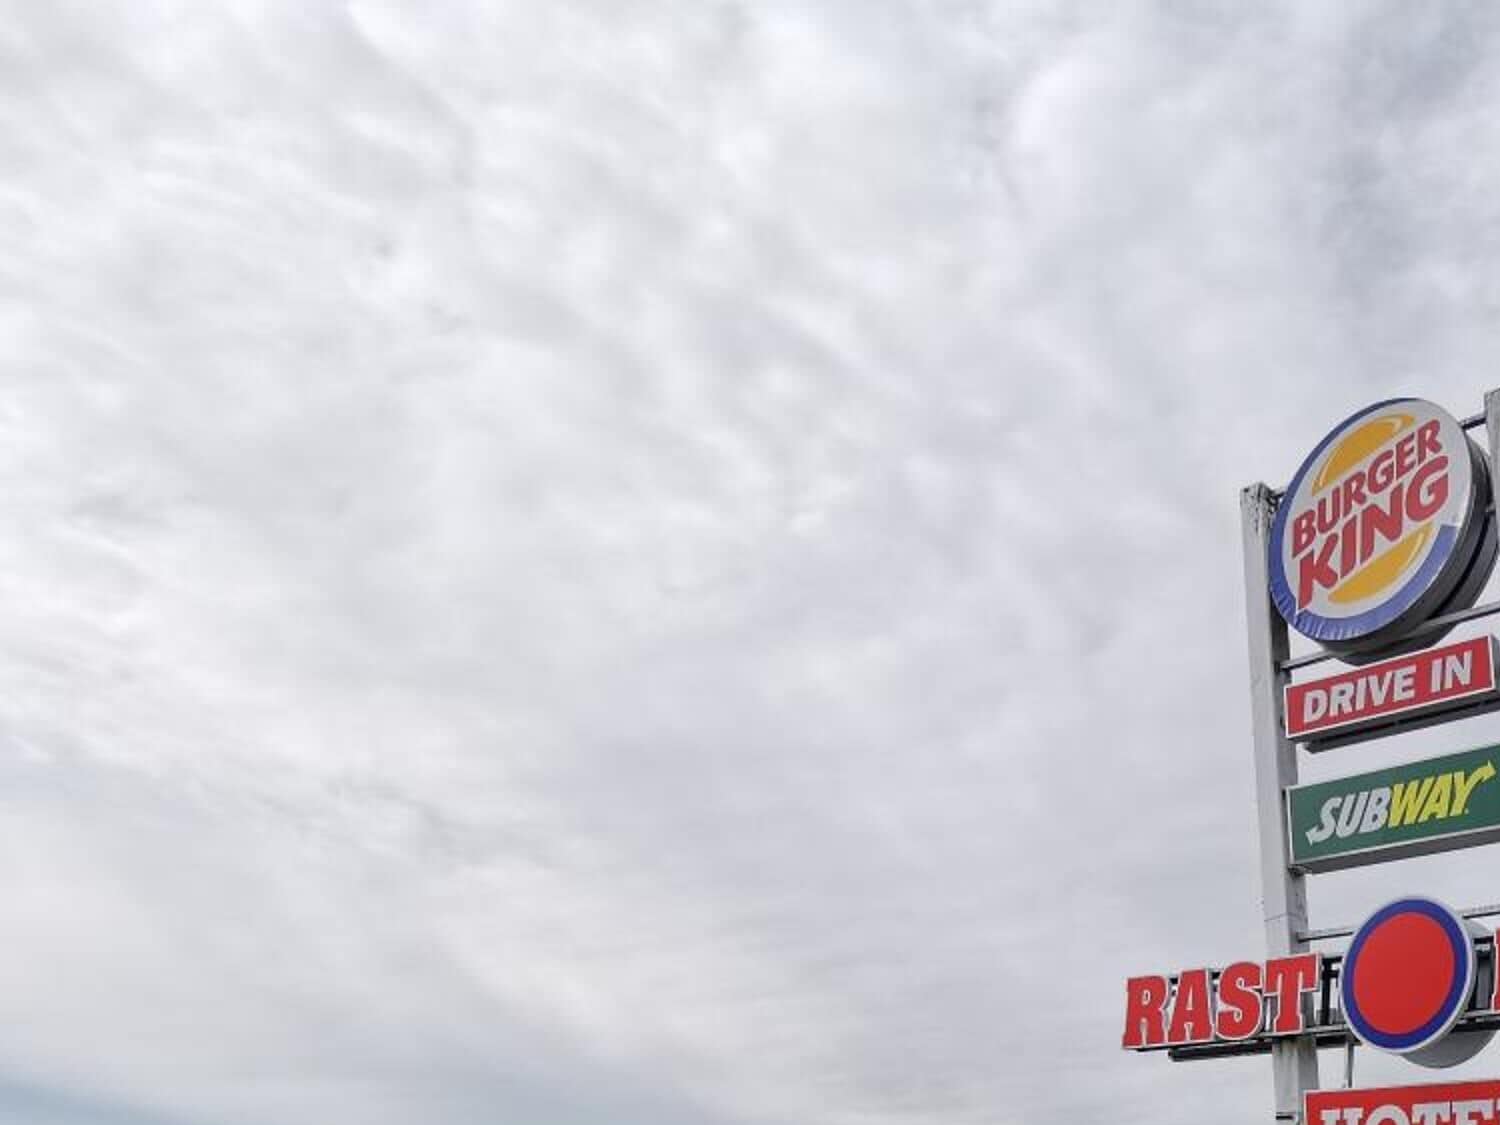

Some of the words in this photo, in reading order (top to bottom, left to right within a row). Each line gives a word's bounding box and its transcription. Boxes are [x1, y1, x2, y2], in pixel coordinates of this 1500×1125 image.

[1292, 420, 1443, 558] BURGER
[1298, 455, 1448, 610] KING
[1303, 665, 1417, 723] DRIVE
[1430, 650, 1473, 693] IN
[1305, 759, 1497, 846] SUBWAY
[1122, 953, 1323, 1050] RAST
